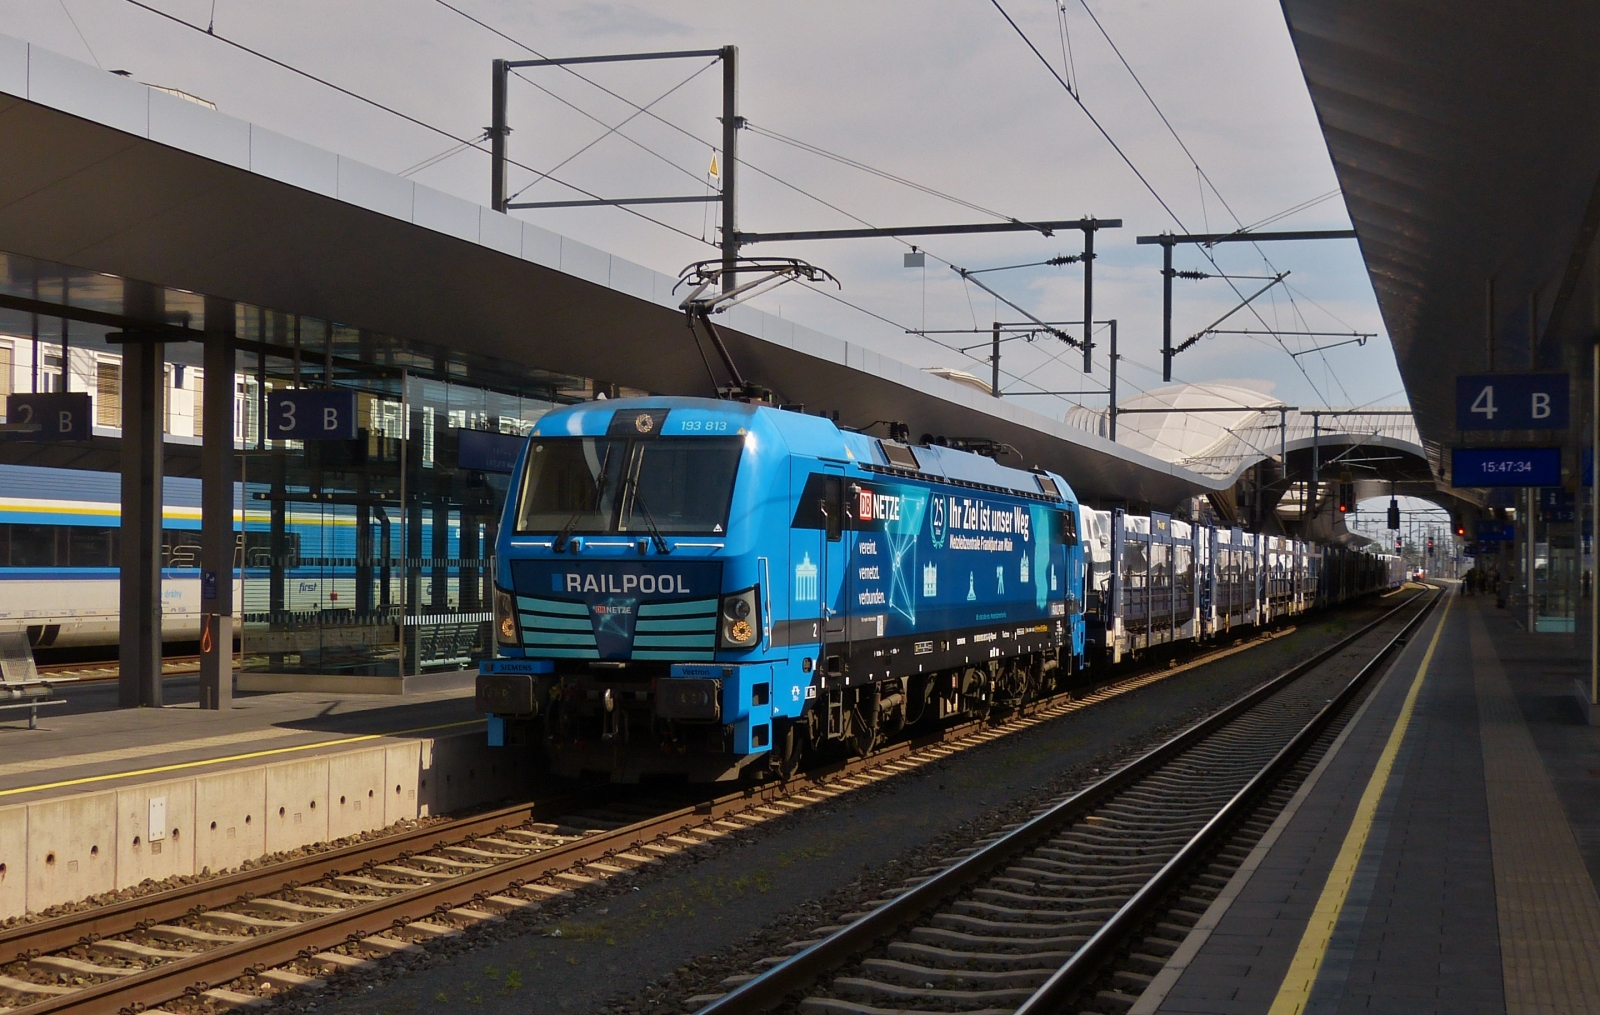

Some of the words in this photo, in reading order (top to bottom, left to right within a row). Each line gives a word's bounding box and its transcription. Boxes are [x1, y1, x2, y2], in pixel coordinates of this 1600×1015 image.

[1470, 385, 1498, 419] 4
[1531, 393, 1551, 419] B
[59, 411, 73, 433] B
[278, 401, 296, 431] 3
[323, 408, 338, 430] B
[681, 420, 701, 431] 193
[705, 420, 727, 431] 813
[1481, 461, 1532, 473] 15:47:34
[861, 492, 871, 517] DB
[872, 494, 900, 520] NETZE
[933, 497, 944, 526] 25
[949, 498, 962, 528] Ihr
[963, 500, 979, 530] Ziel
[980, 503, 991, 531] ist
[991, 510, 1013, 533] unser
[1013, 506, 1029, 541] Weg
[859, 539, 878, 554] vereint.
[981, 536, 997, 553] Frankfurt
[299, 581, 318, 593] first
[565, 573, 690, 594] RAILPOOL
[859, 589, 886, 605] verbunden.
[606, 605, 632, 614] NETZE
[812, 623, 818, 638] 2
[500, 664, 532, 672] SIEMENS
[682, 667, 710, 675] Vectron
